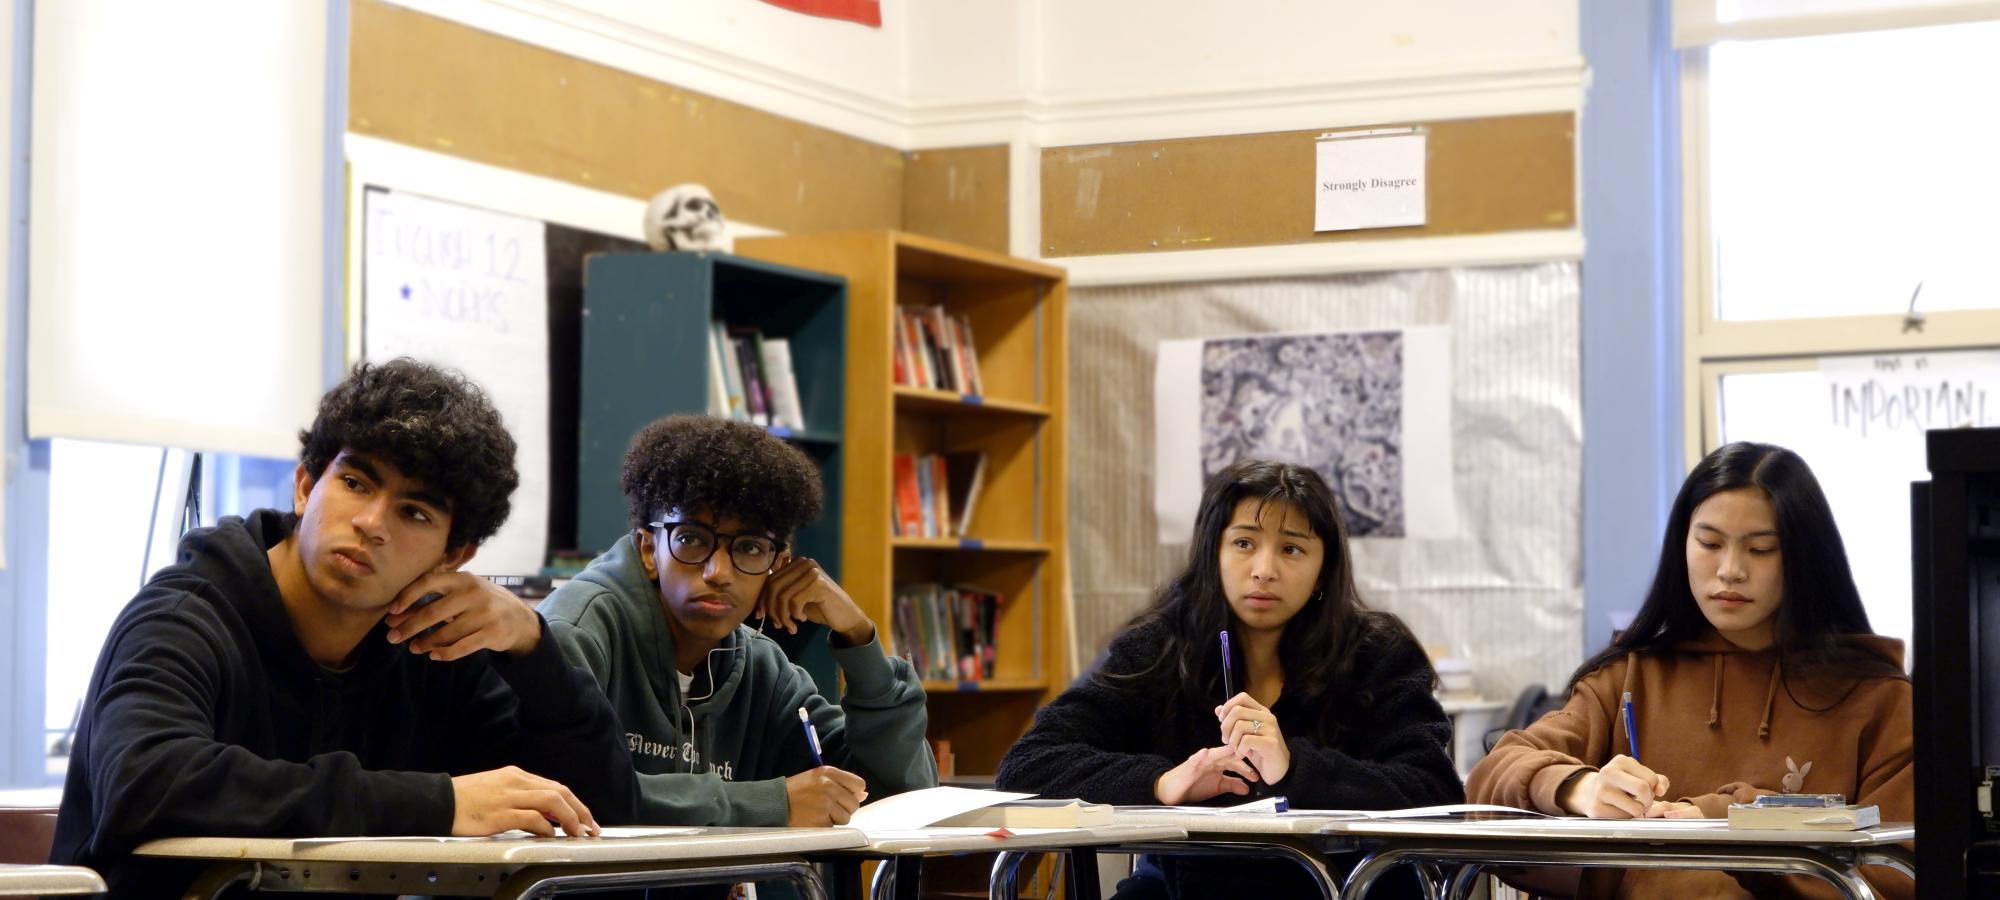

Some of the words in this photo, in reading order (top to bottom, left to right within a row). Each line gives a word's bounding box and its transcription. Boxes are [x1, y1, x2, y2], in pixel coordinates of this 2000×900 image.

[1322, 179, 1367, 192] Strongly
[1371, 177, 1417, 190] Disagree
[485, 233, 528, 284] 12
[625, 733, 677, 759] Never
